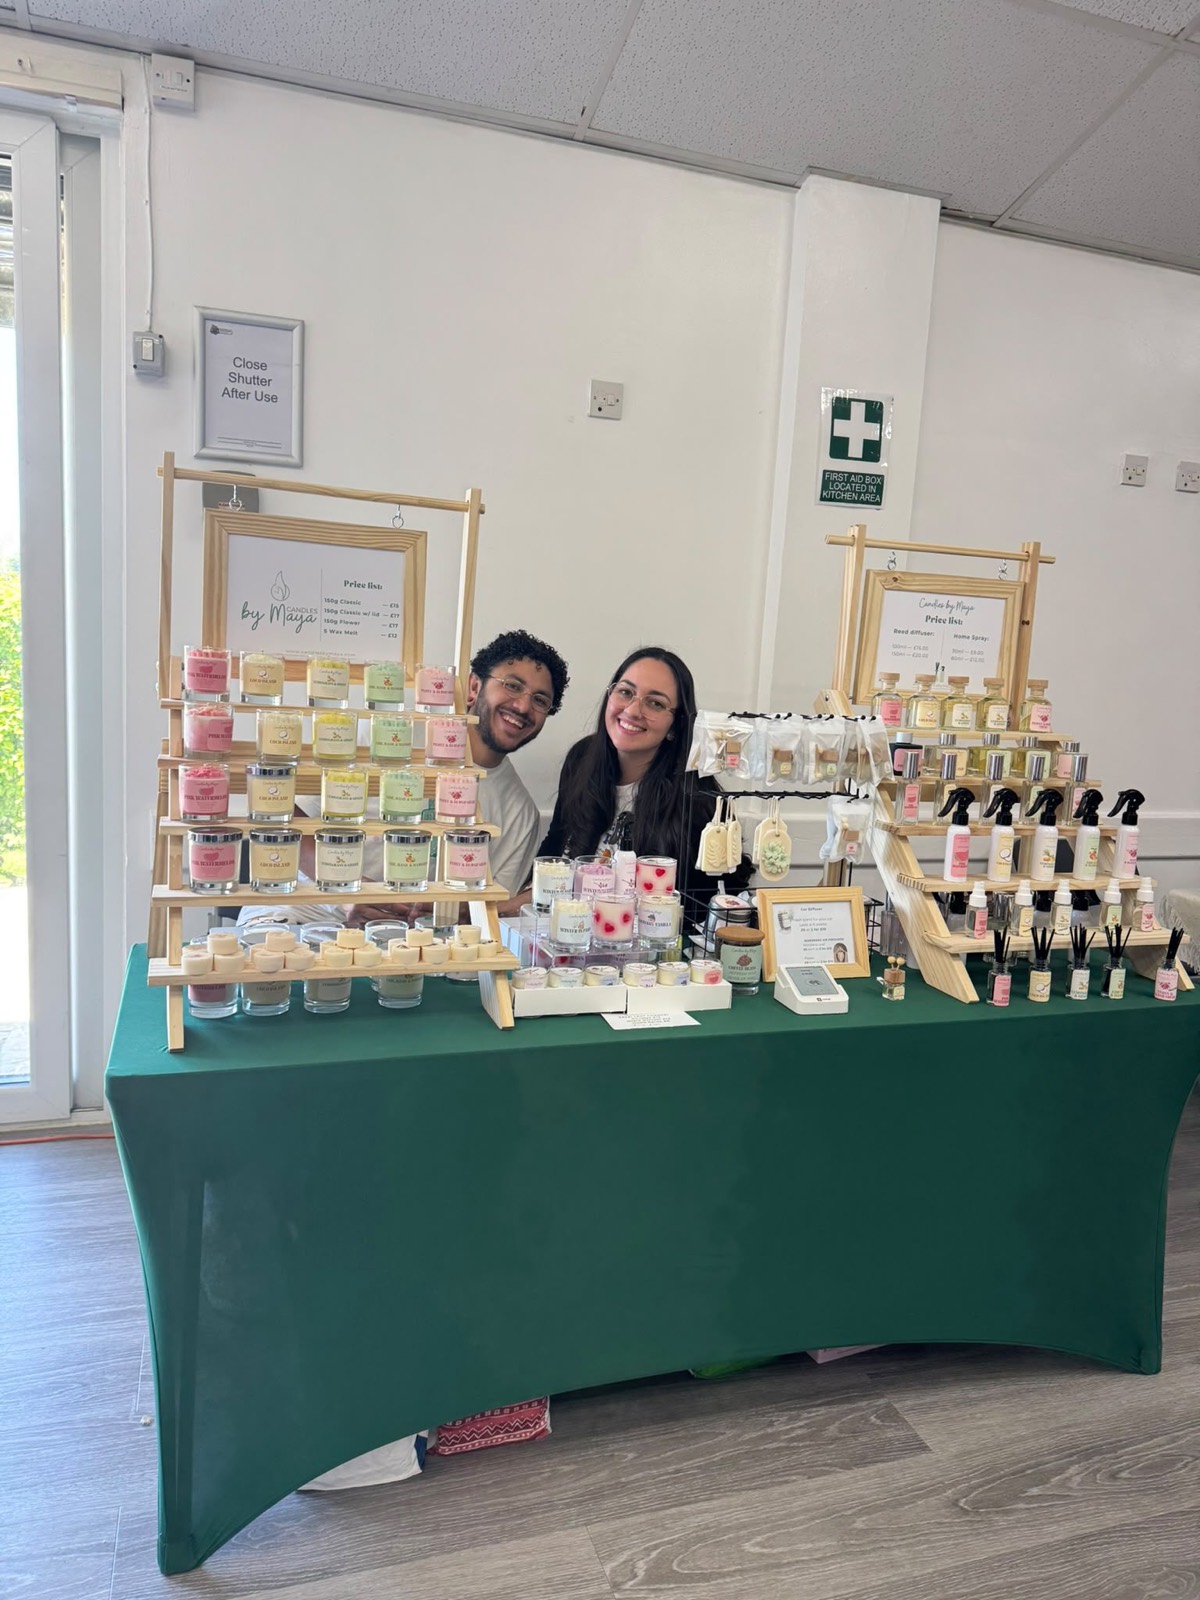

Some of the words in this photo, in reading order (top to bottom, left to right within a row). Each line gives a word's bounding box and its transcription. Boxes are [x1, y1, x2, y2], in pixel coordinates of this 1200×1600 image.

[233, 357, 267, 371] Close
[228, 372, 272, 387] Shutter
[221, 387, 251, 400] After
[254, 390, 278, 403] Use
[825, 472, 848, 482] FIRST
[849, 473, 864, 483] AID
[865, 475, 882, 485] BOX
[829, 482, 867, 492] LOCATED
[868, 485, 877, 493] IN
[822, 490, 858, 500] KITCHEN
[859, 493, 881, 502] AREA
[344, 580, 366, 589] Price
[367, 582, 383, 590] list:
[286, 606, 318, 614] CANDLES
[919, 597, 945, 609] Candles
[945, 600, 954, 615] by
[955, 601, 975, 616] Maya
[241, 601, 265, 631] by
[269, 603, 317, 634] Maya
[925, 615, 946, 624] Price
[948, 617, 963, 626] list:
